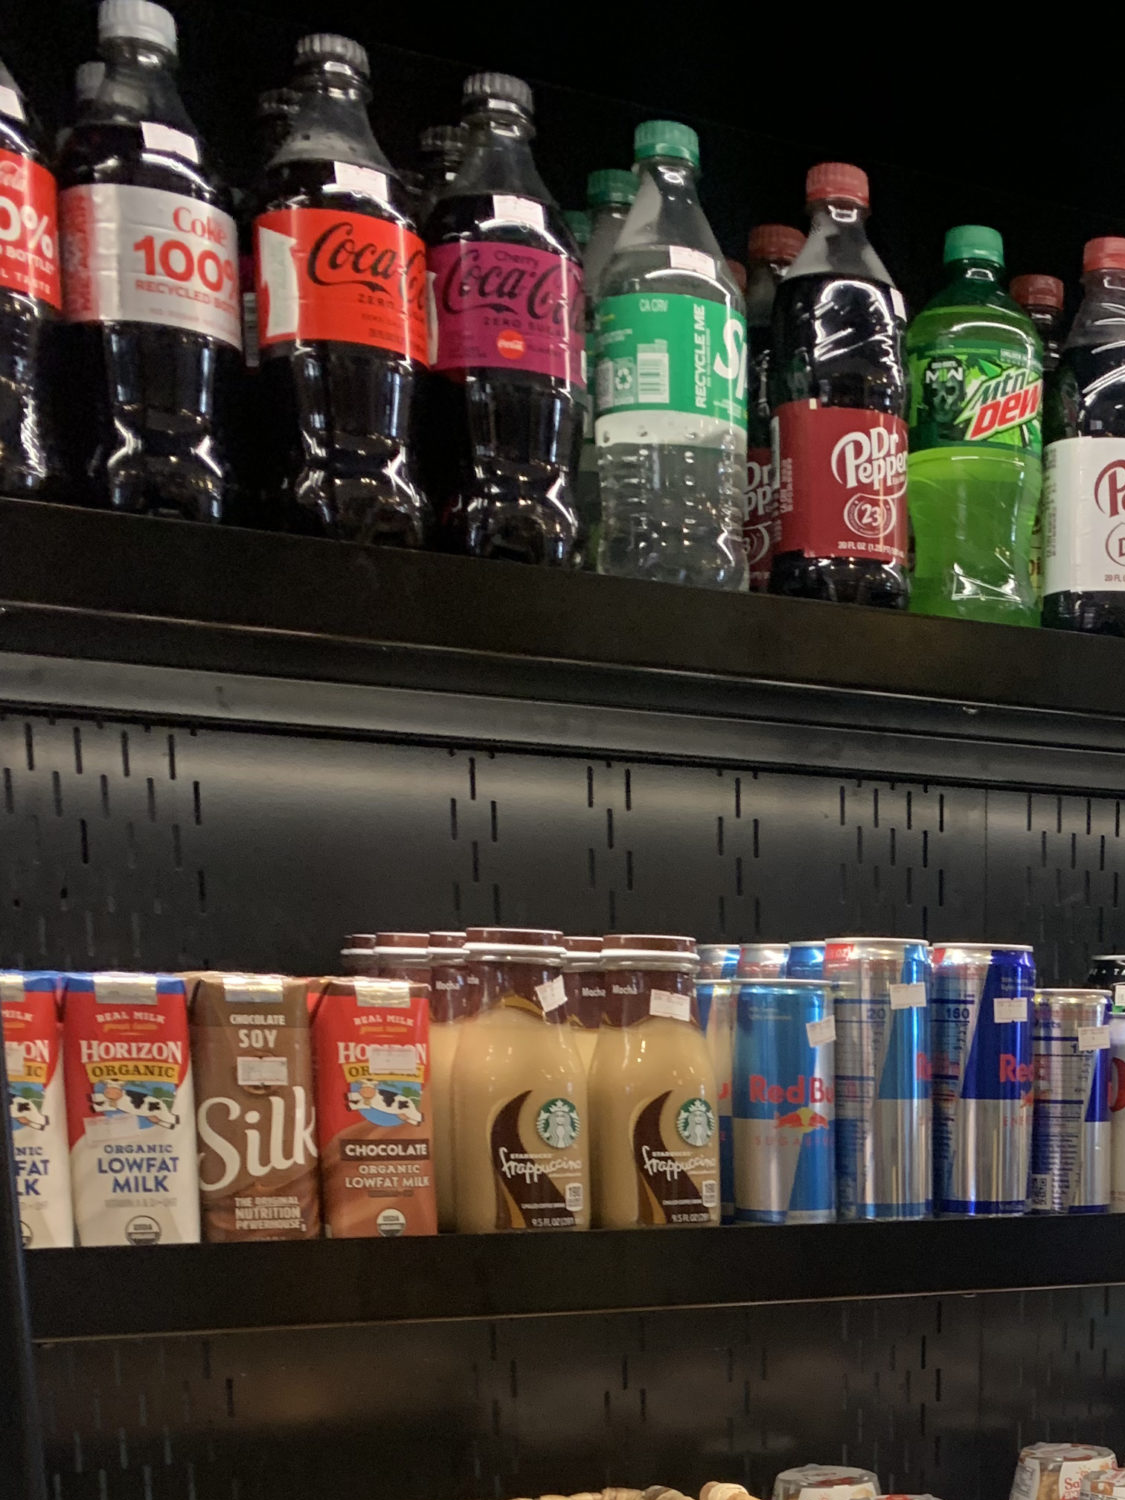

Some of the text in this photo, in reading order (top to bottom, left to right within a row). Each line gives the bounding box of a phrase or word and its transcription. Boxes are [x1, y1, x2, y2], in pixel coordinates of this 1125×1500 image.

[135, 279, 211, 304] RECYCLED
[693, 303, 708, 408] RECYCLE ME
[972, 370, 1026, 411] Mtn
[871, 427, 899, 452] Dr
[861, 504, 881, 527] 23
[612, 983, 638, 996] Mocha
[96, 1011, 165, 1024] REAL MILK
[230, 1014, 286, 1026] CHOCOLATE
[354, 1014, 413, 1027] REAL MILK
[238, 1030, 277, 1048] SOY
[80, 1040, 182, 1064] HORIZON
[92, 1064, 175, 1079] ORGANIC
[750, 1075, 805, 1105] Red
[198, 1086, 318, 1192] Silk
[104, 1145, 172, 1154] ORGANIC
[345, 1144, 427, 1157] CHOCOLATE
[98, 1157, 179, 1173] LOWFAT
[359, 1164, 420, 1174] ORGANIC
[112, 1176, 169, 1193] MILK
[346, 1176, 430, 1188] LOWFAT MILK
[236, 1207, 300, 1220] NUTRITION
